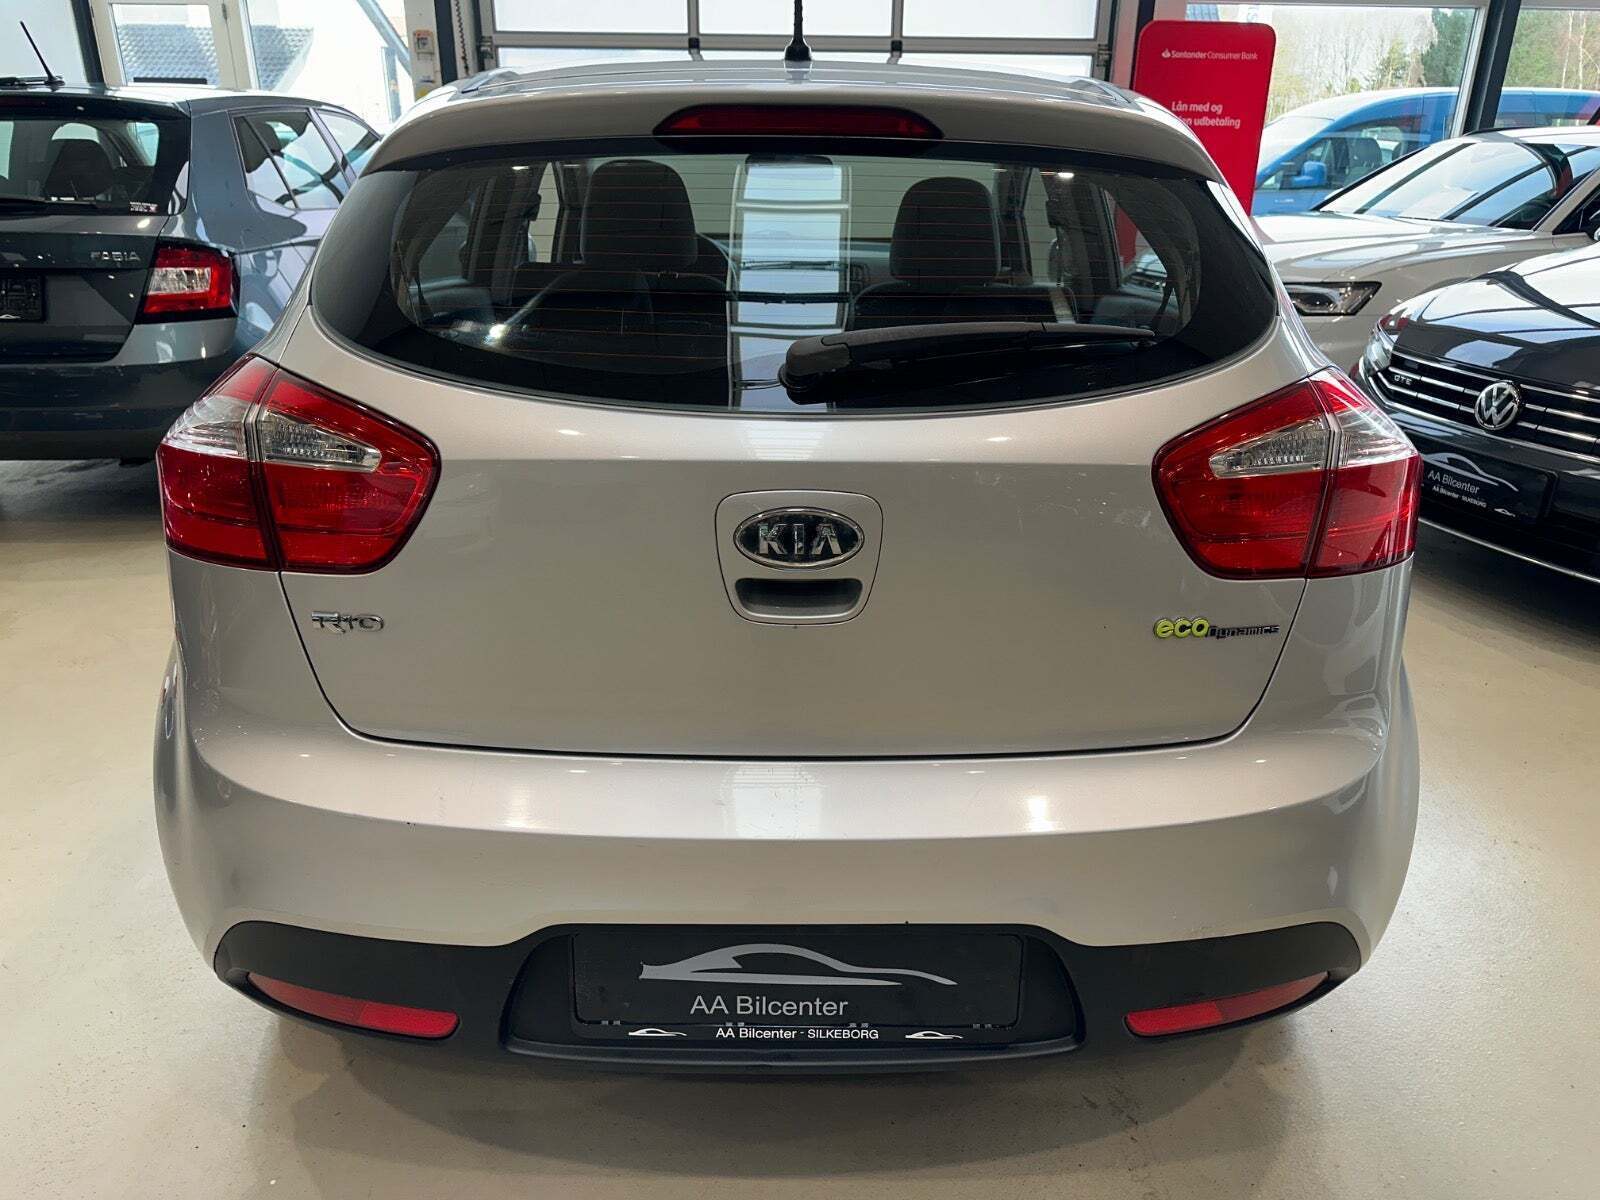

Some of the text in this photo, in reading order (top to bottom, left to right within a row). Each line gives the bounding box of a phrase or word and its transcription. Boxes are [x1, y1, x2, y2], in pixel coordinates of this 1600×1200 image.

[1171, 50, 1258, 60] Santander Consumer Bank
[1171, 100, 1223, 115] Lån med og
[1193, 116, 1241, 130] udbetaling
[1394, 374, 1412, 386] GTE
[1427, 470, 1480, 495] AA Bilcenter
[757, 523, 843, 556] KIA
[690, 995, 849, 1016] AA Bilcenter
[715, 1028, 736, 1039] AA
[739, 1028, 797, 1040] Bilcenter
[807, 1028, 880, 1040] SILKEBORG
